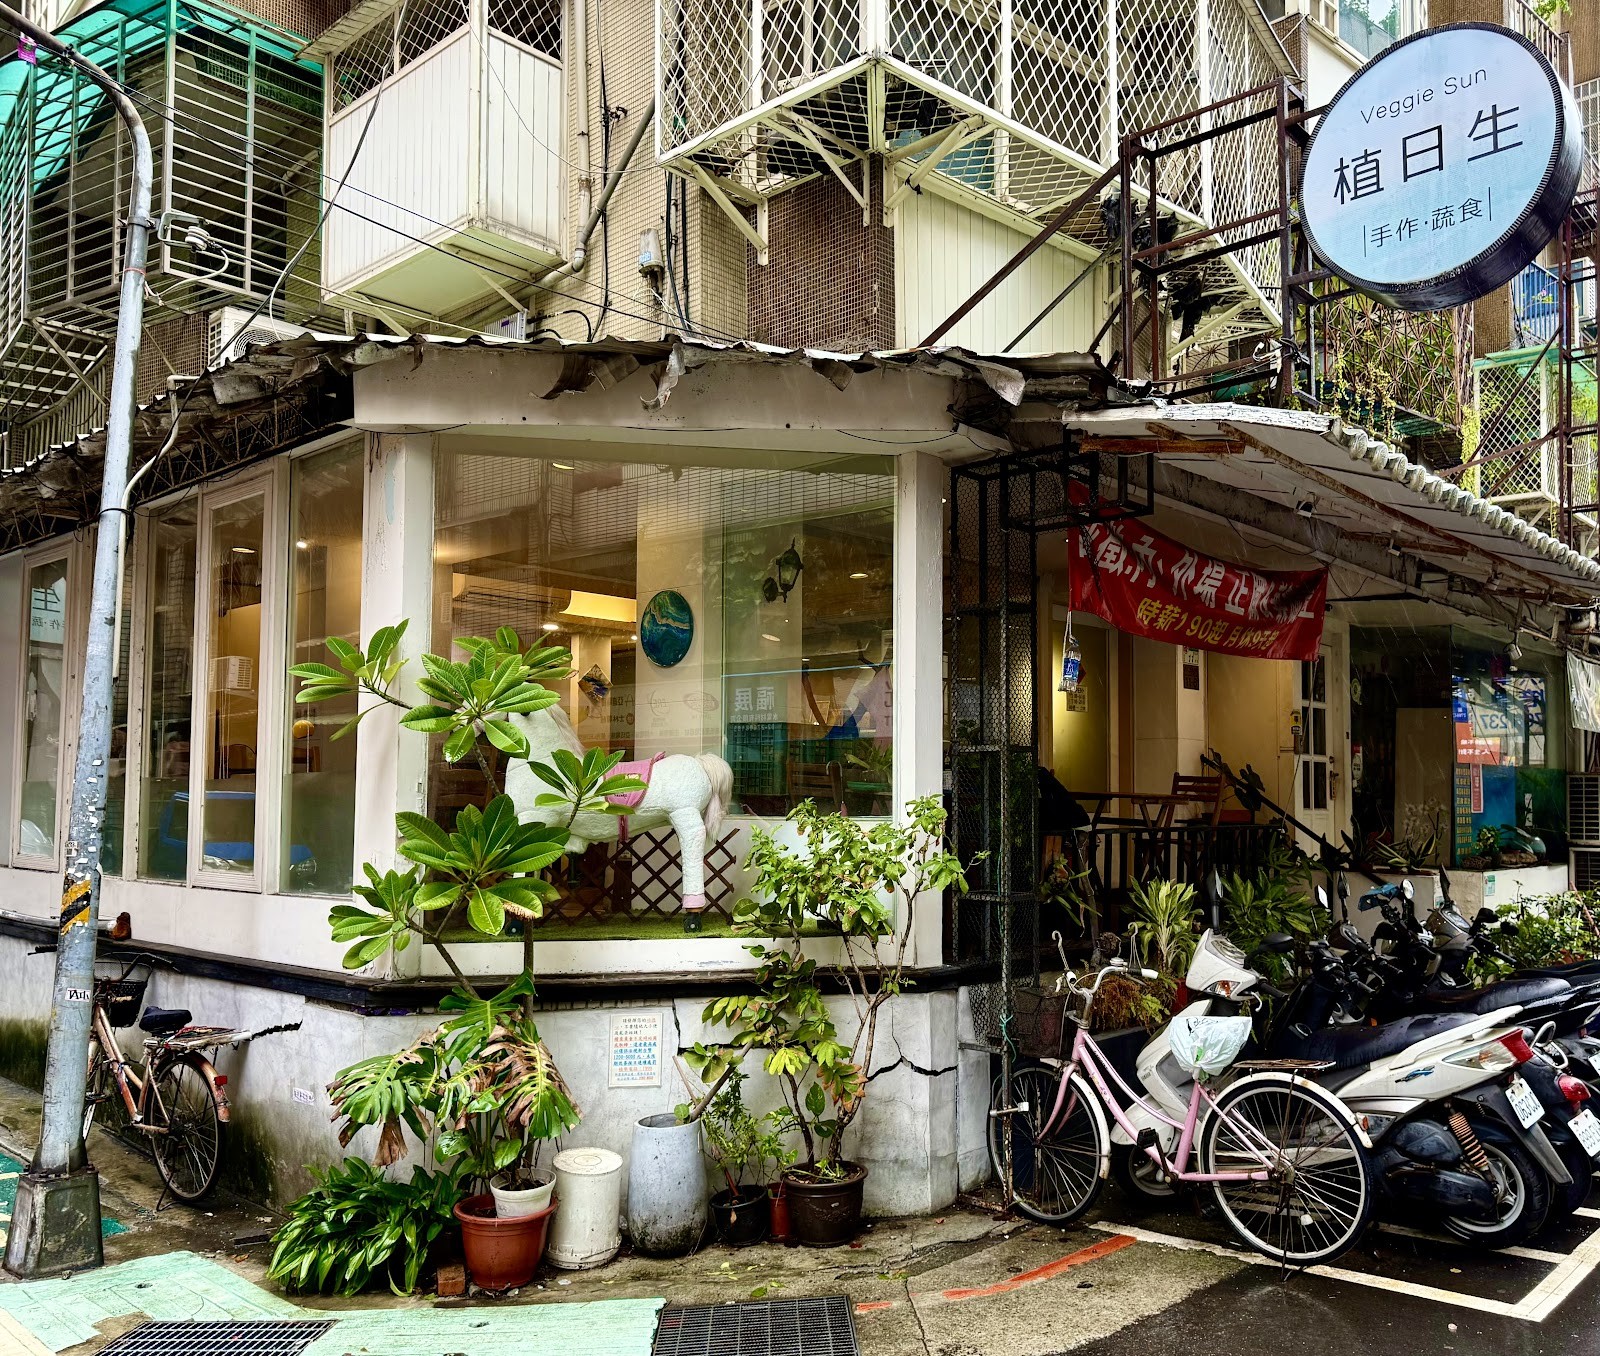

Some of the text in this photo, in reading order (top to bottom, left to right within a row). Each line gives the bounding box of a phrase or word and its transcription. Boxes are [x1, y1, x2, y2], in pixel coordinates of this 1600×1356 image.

[1360, 68, 1488, 125] Veggie Sun
[1333, 103, 1524, 206] 植日生
